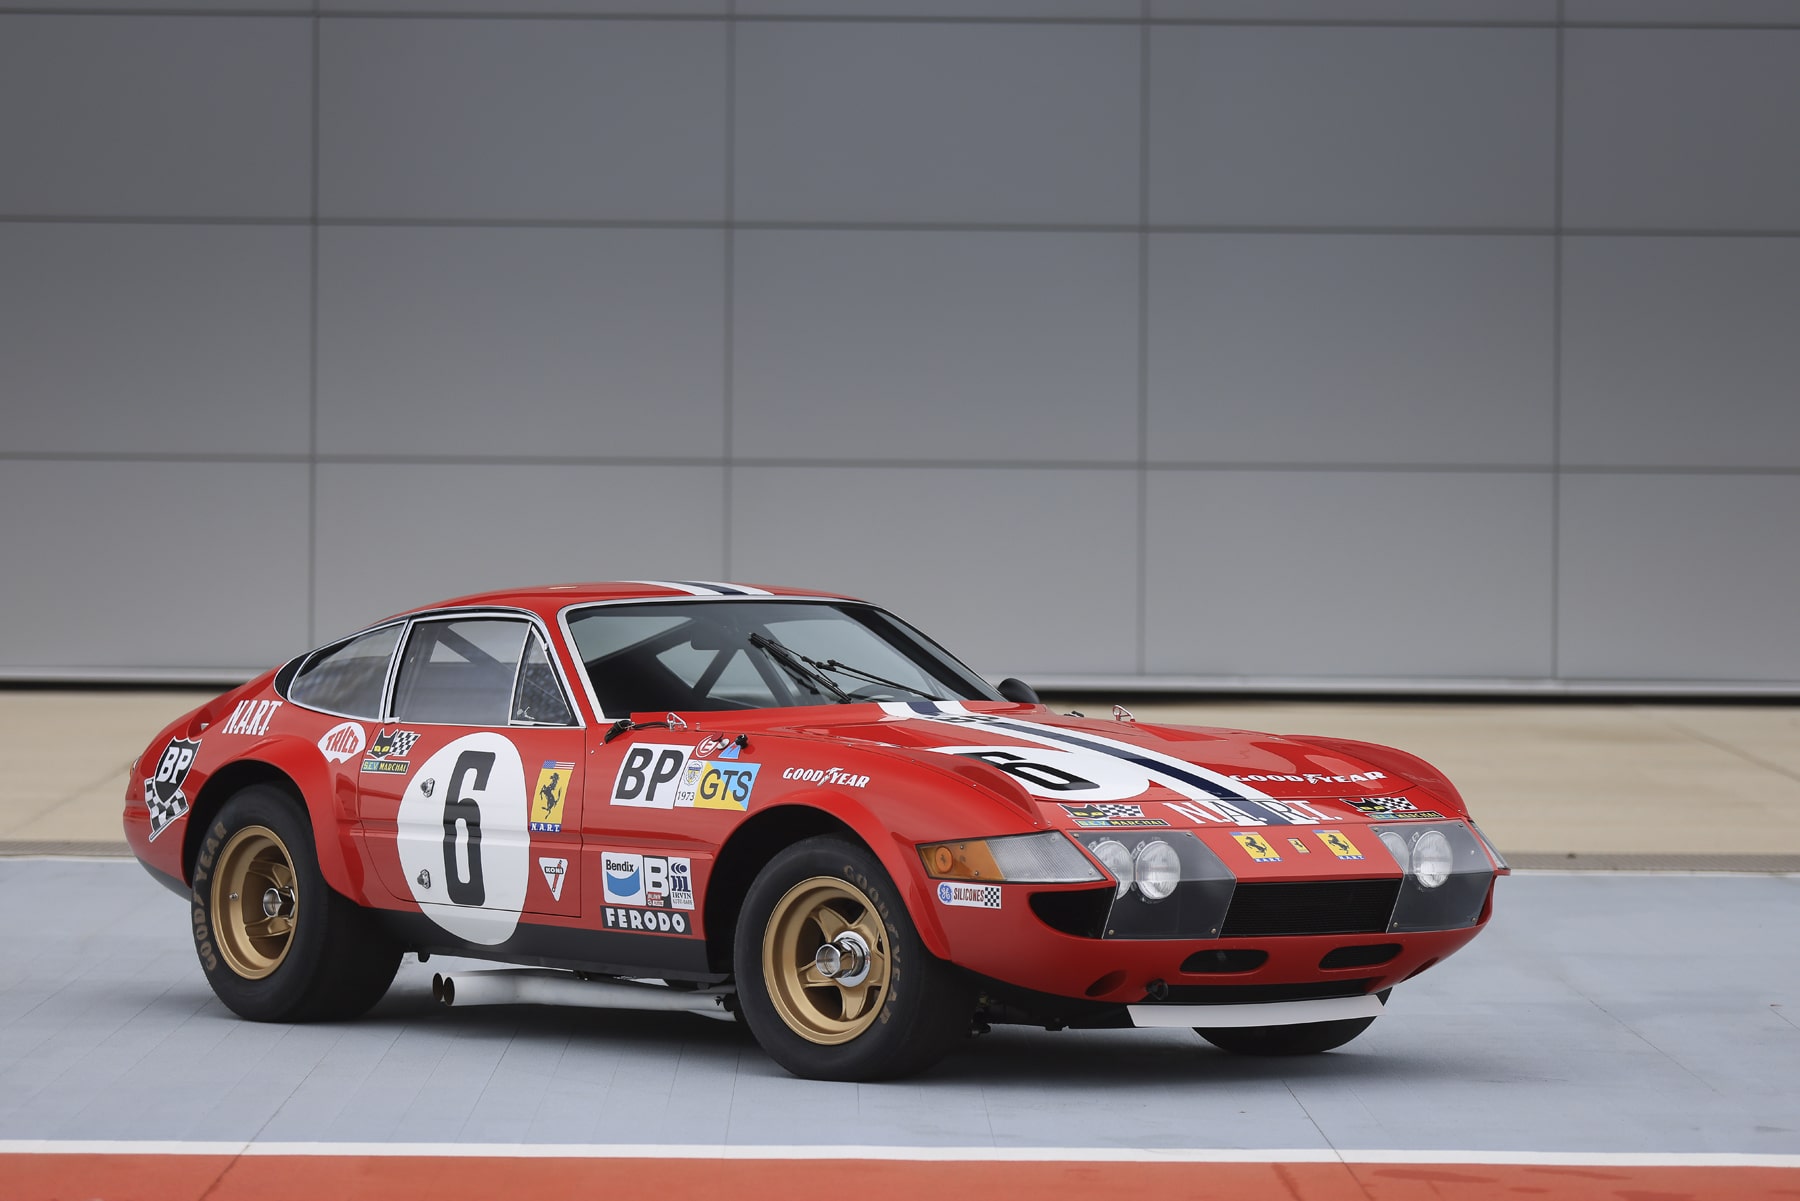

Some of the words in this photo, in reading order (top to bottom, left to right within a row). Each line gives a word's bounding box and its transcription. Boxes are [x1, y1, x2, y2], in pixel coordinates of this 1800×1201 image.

[325, 726, 360, 754] TRICO
[156, 746, 194, 784] BP
[379, 762, 407, 772] MARCHAL
[615, 748, 684, 801] BP
[953, 751, 1100, 791] 6
[677, 790, 695, 801] 1973
[700, 768, 753, 802] GTS
[443, 750, 496, 906] 6
[606, 859, 634, 872] Bendix
[953, 887, 985, 903] SILICONES
[605, 907, 686, 933] FERODO
